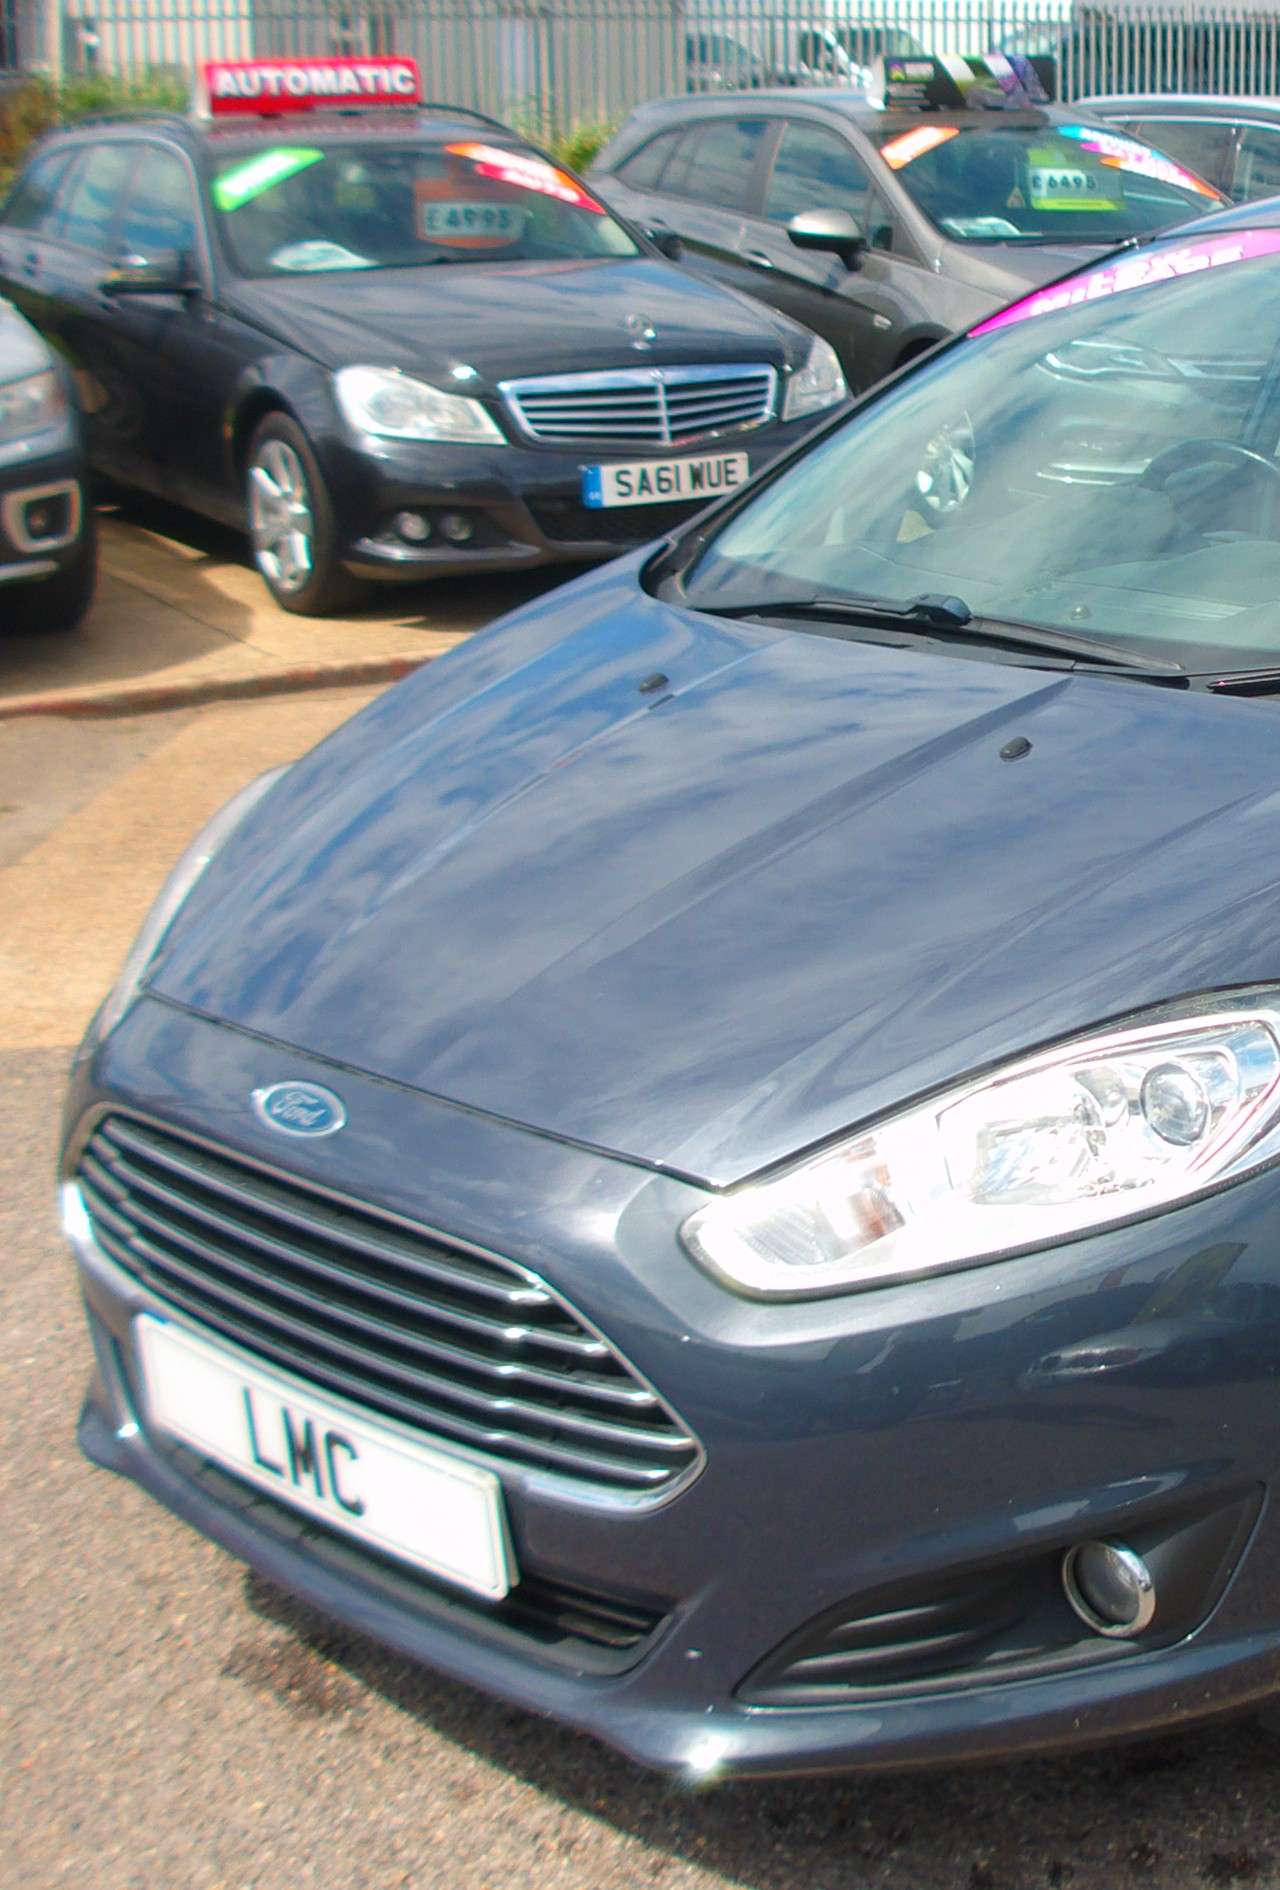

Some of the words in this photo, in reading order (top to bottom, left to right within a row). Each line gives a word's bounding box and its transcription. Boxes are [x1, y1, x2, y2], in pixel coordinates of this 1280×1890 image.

[216, 64, 417, 97] AUTOMATIC
[614, 464, 681, 498] SA61
[689, 457, 739, 492] WUE
[241, 1385, 365, 1518] LMC
